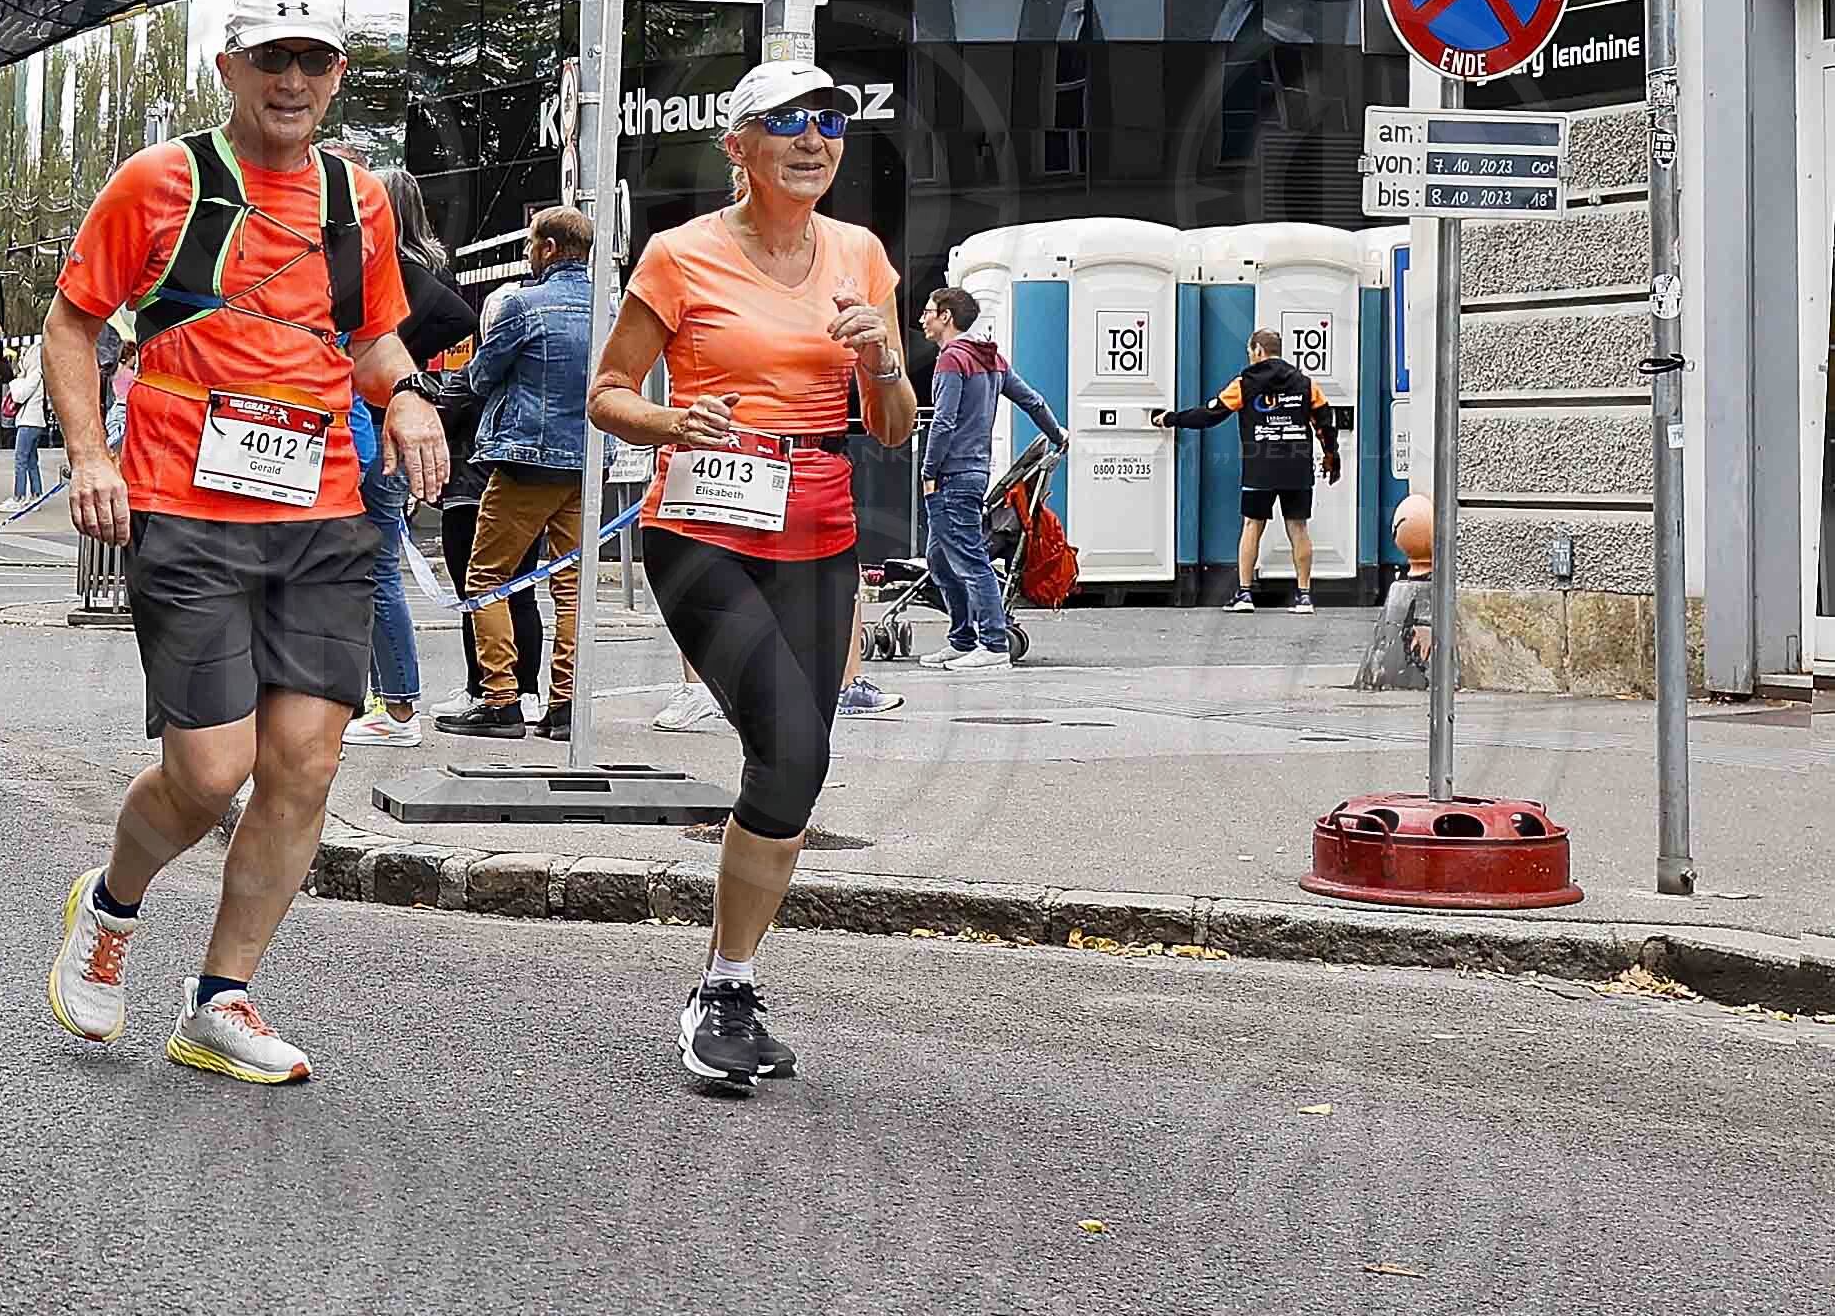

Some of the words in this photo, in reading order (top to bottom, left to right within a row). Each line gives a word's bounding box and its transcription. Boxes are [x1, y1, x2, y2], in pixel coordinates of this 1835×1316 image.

[1439, 48, 1488, 76] ENDE
[1552, 34, 1640, 69] lendnine
[539, 87, 734, 148] Kthaus
[1108, 350, 1143, 371] TOI
[1292, 350, 1327, 372] TOI
[244, 402, 270, 413] GRAZ
[240, 430, 298, 460] 4012
[249, 460, 282, 475] Gerald
[692, 456, 753, 483] 4013
[1093, 464, 1115, 475] 0800
[1117, 464, 1133, 475] 230
[1135, 464, 1152, 475] 235
[695, 485, 744, 500] Elisabeth
